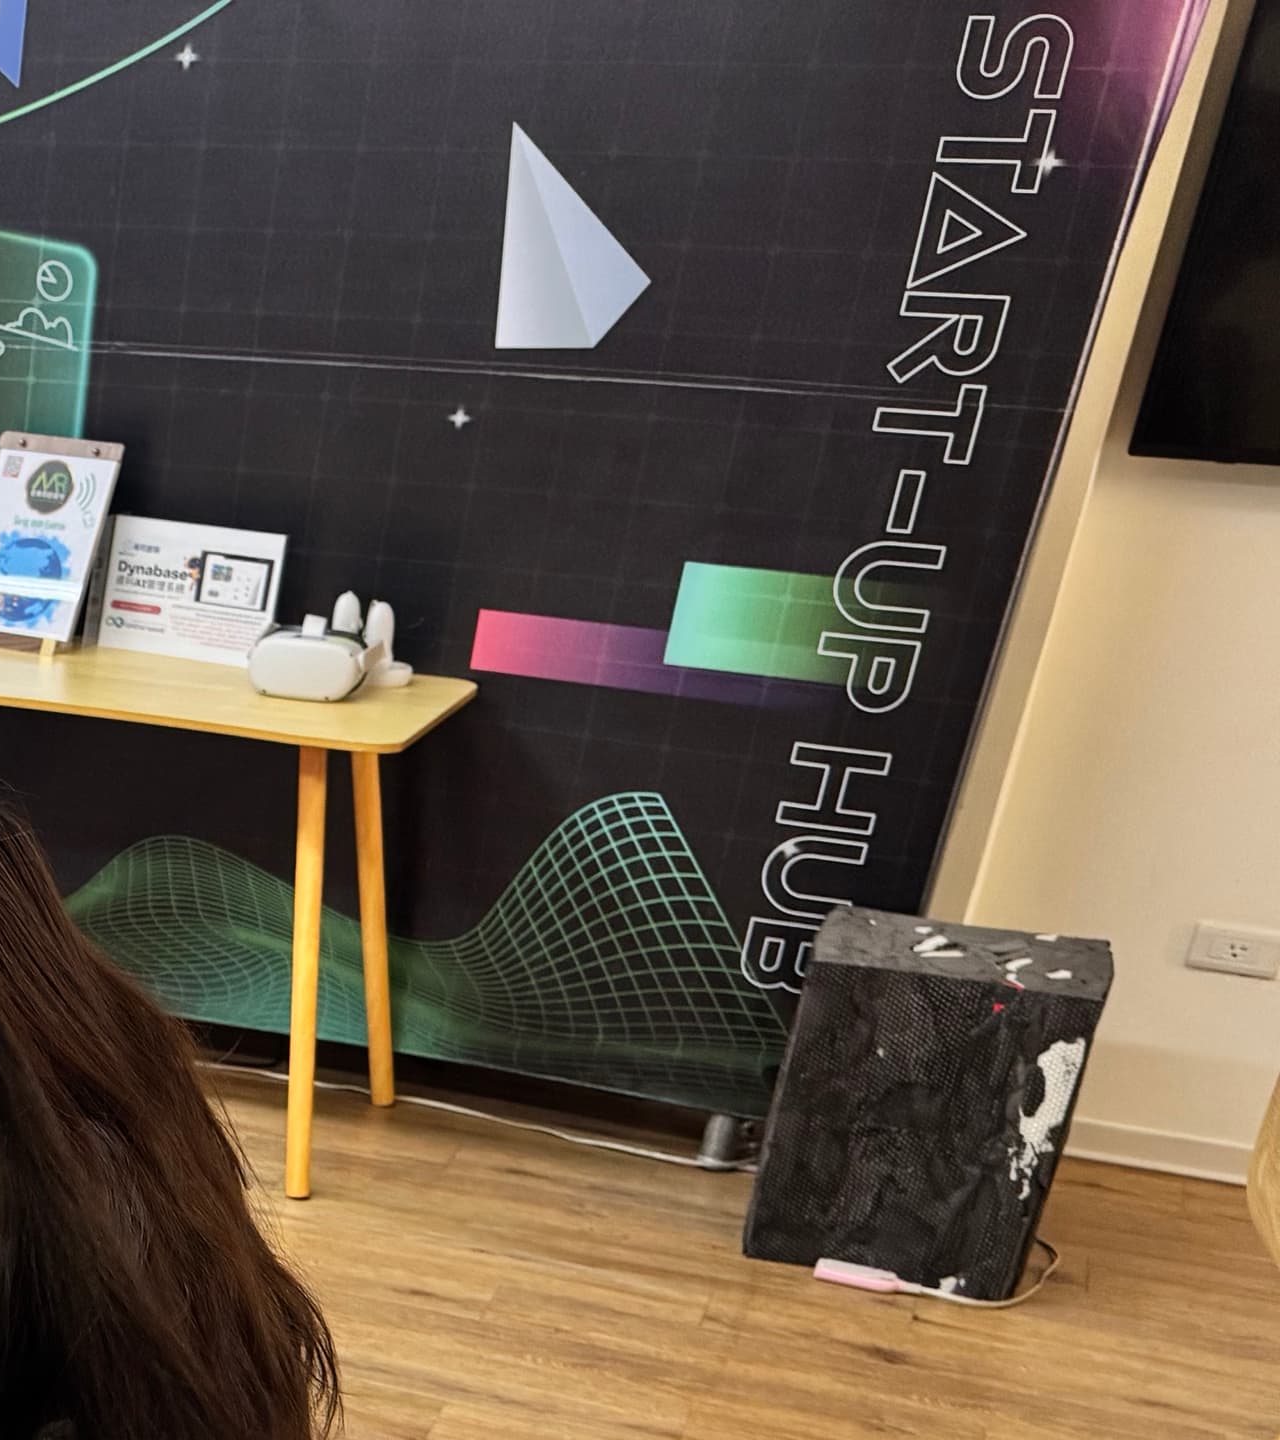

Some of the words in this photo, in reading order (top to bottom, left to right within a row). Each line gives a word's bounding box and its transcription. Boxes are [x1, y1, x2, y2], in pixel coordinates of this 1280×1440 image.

[817, 13, 1074, 714] START-UP
[117, 560, 189, 582] Dynabase
[741, 741, 892, 991] HUB
